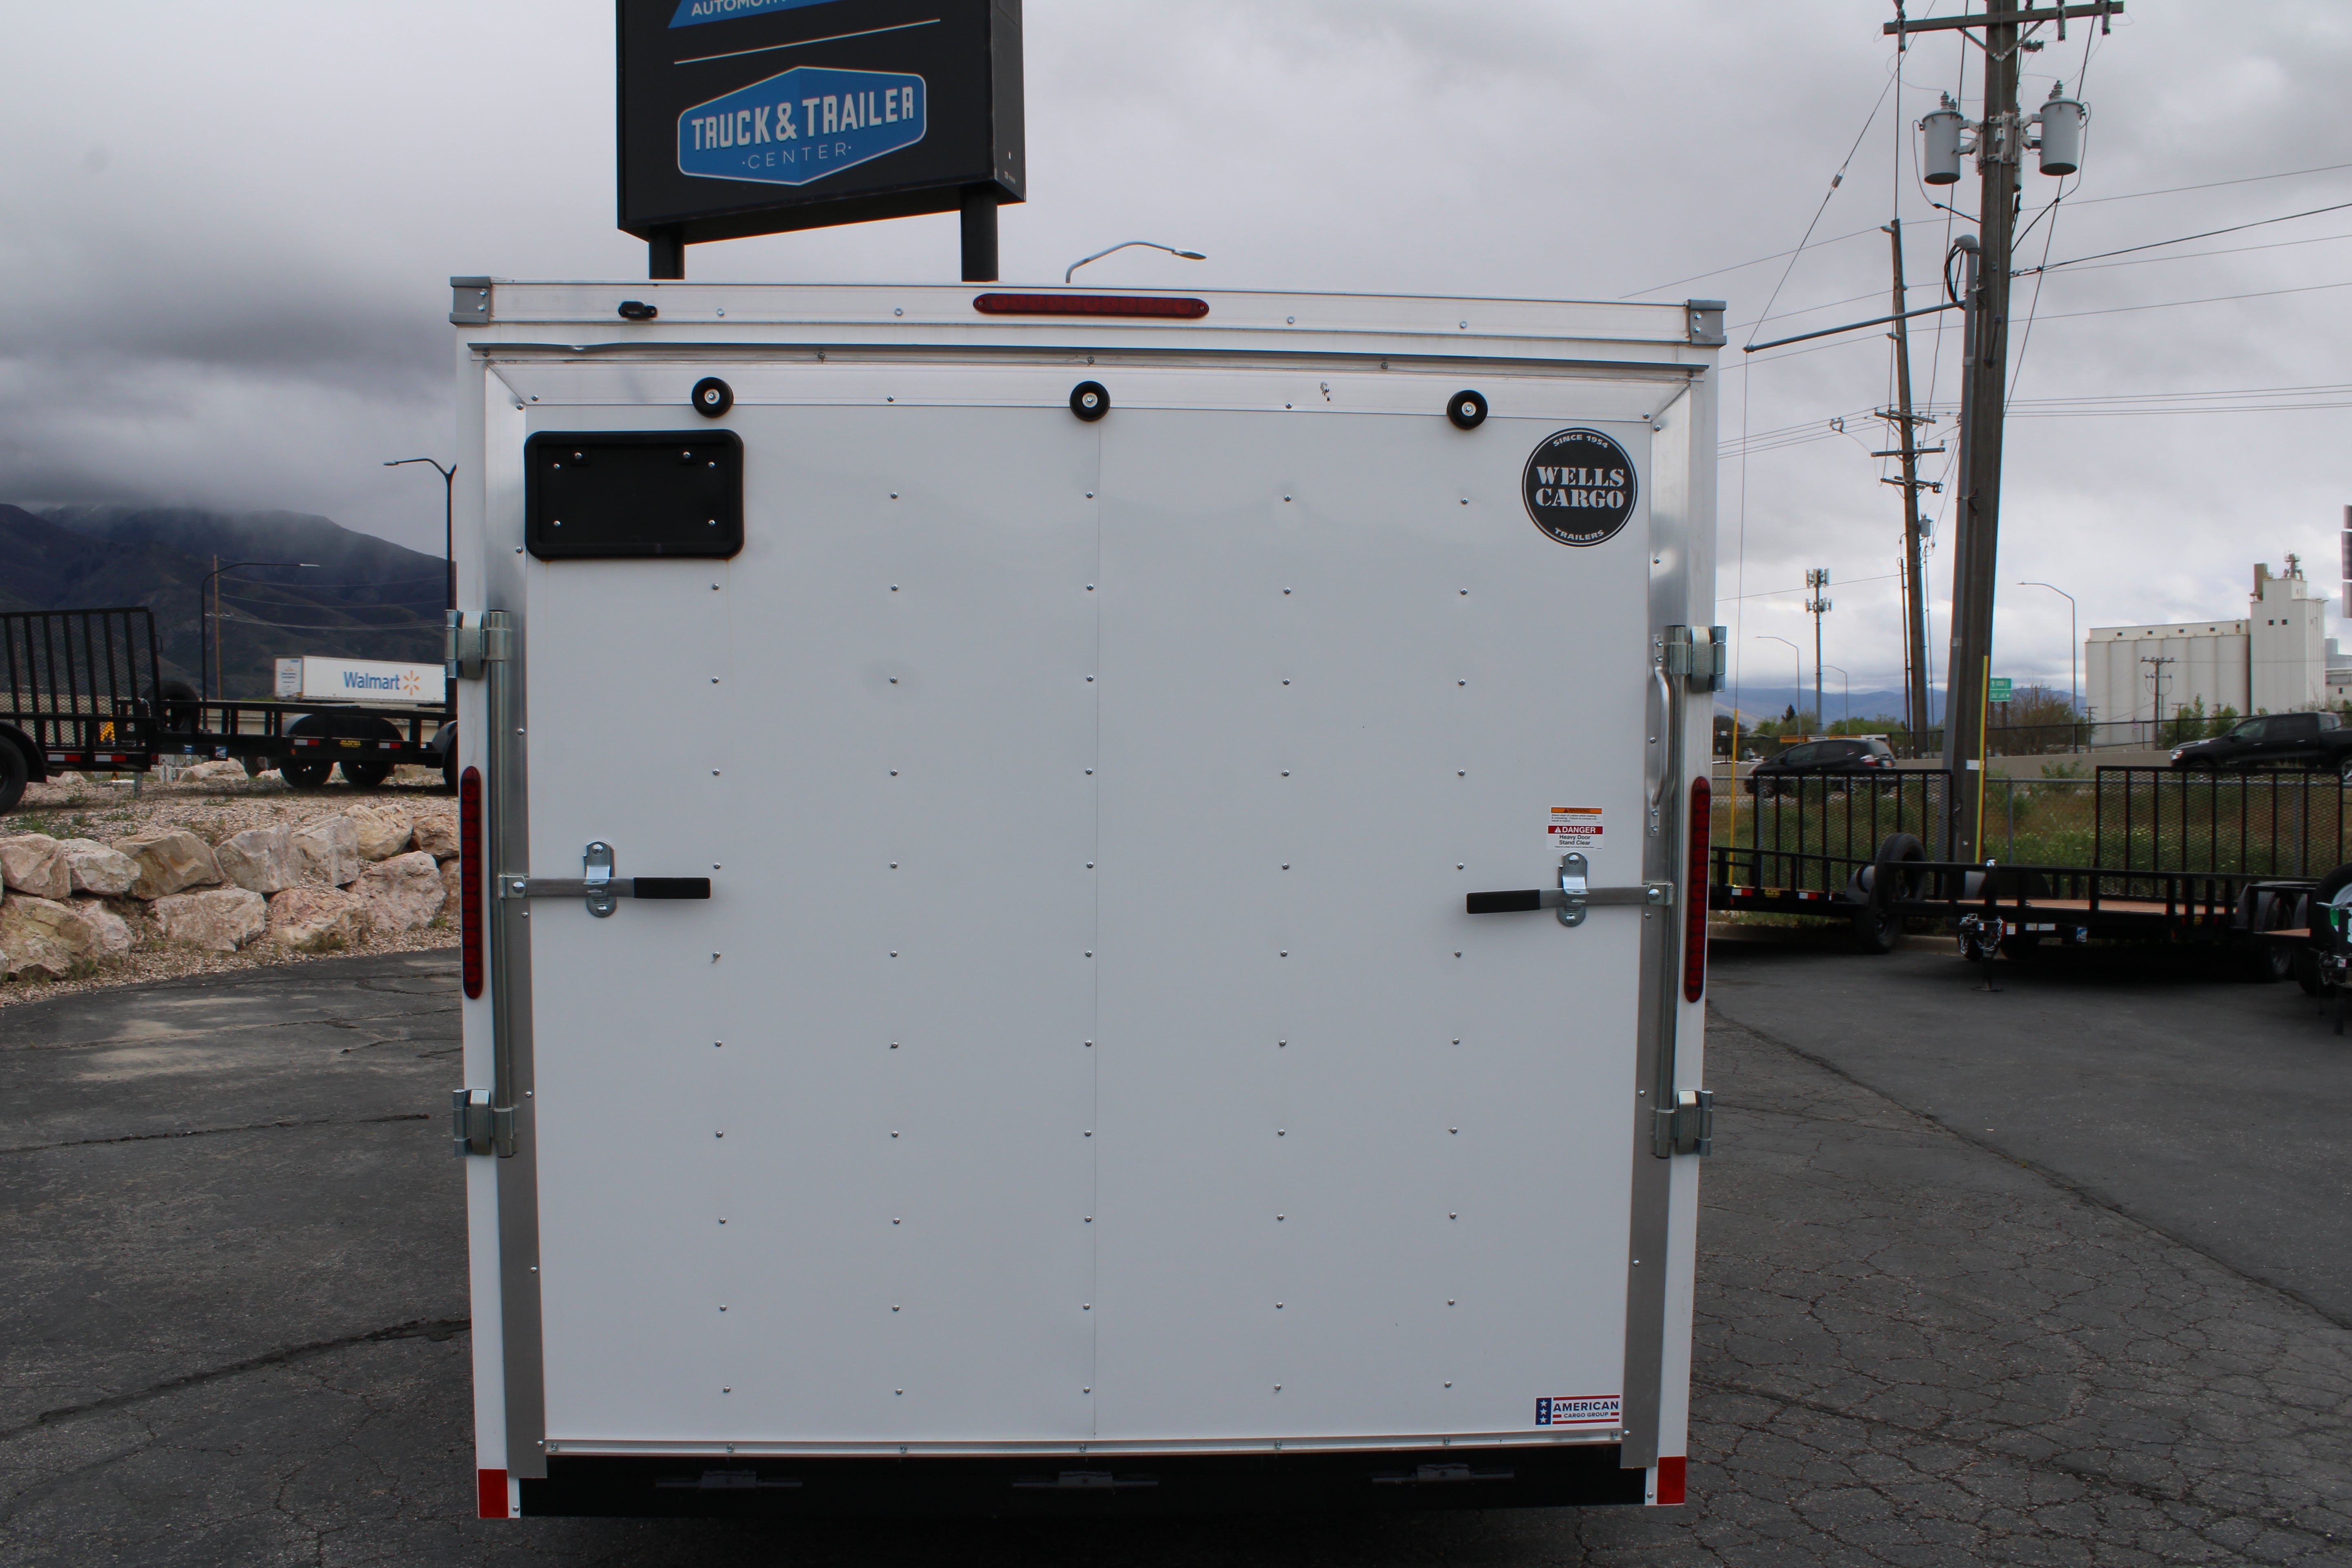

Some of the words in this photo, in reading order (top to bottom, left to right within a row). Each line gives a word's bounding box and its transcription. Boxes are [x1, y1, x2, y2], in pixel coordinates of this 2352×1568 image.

[692, 106, 771, 151] TRUCK
[775, 102, 797, 141] &
[802, 86, 914, 137] TRAILER
[748, 142, 846, 169] CENTER
[1553, 434, 1583, 447] SINCE
[1586, 436, 1609, 448] 1954
[1536, 466, 1625, 487] WELLS
[1535, 488, 1625, 509] CARGO
[1555, 527, 1604, 541] TRAILERS
[343, 671, 400, 690] Walmart
[1553, 1401, 1619, 1412] AMERICAN
